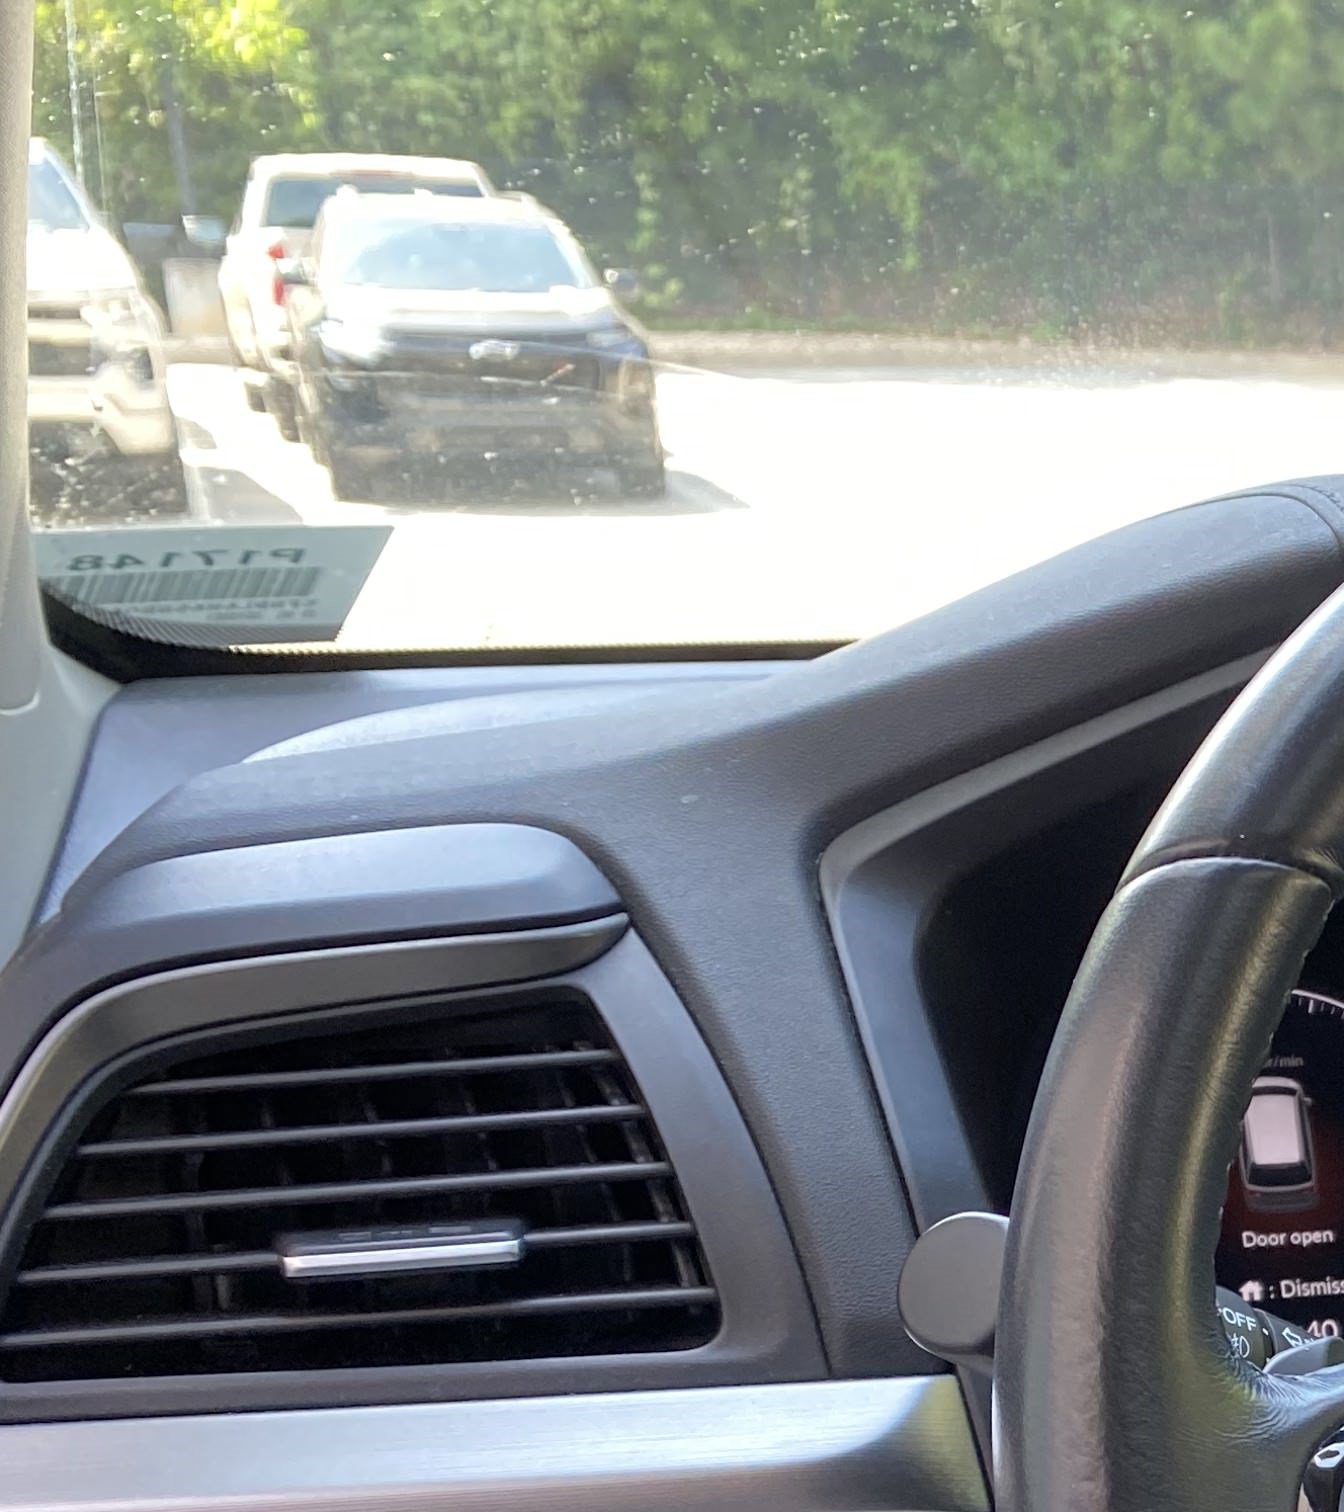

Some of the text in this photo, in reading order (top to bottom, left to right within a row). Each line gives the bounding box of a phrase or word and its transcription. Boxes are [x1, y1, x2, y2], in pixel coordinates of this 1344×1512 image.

[1241, 1228, 1335, 1248] Door open
[1223, 1307, 1257, 1332] OFF
